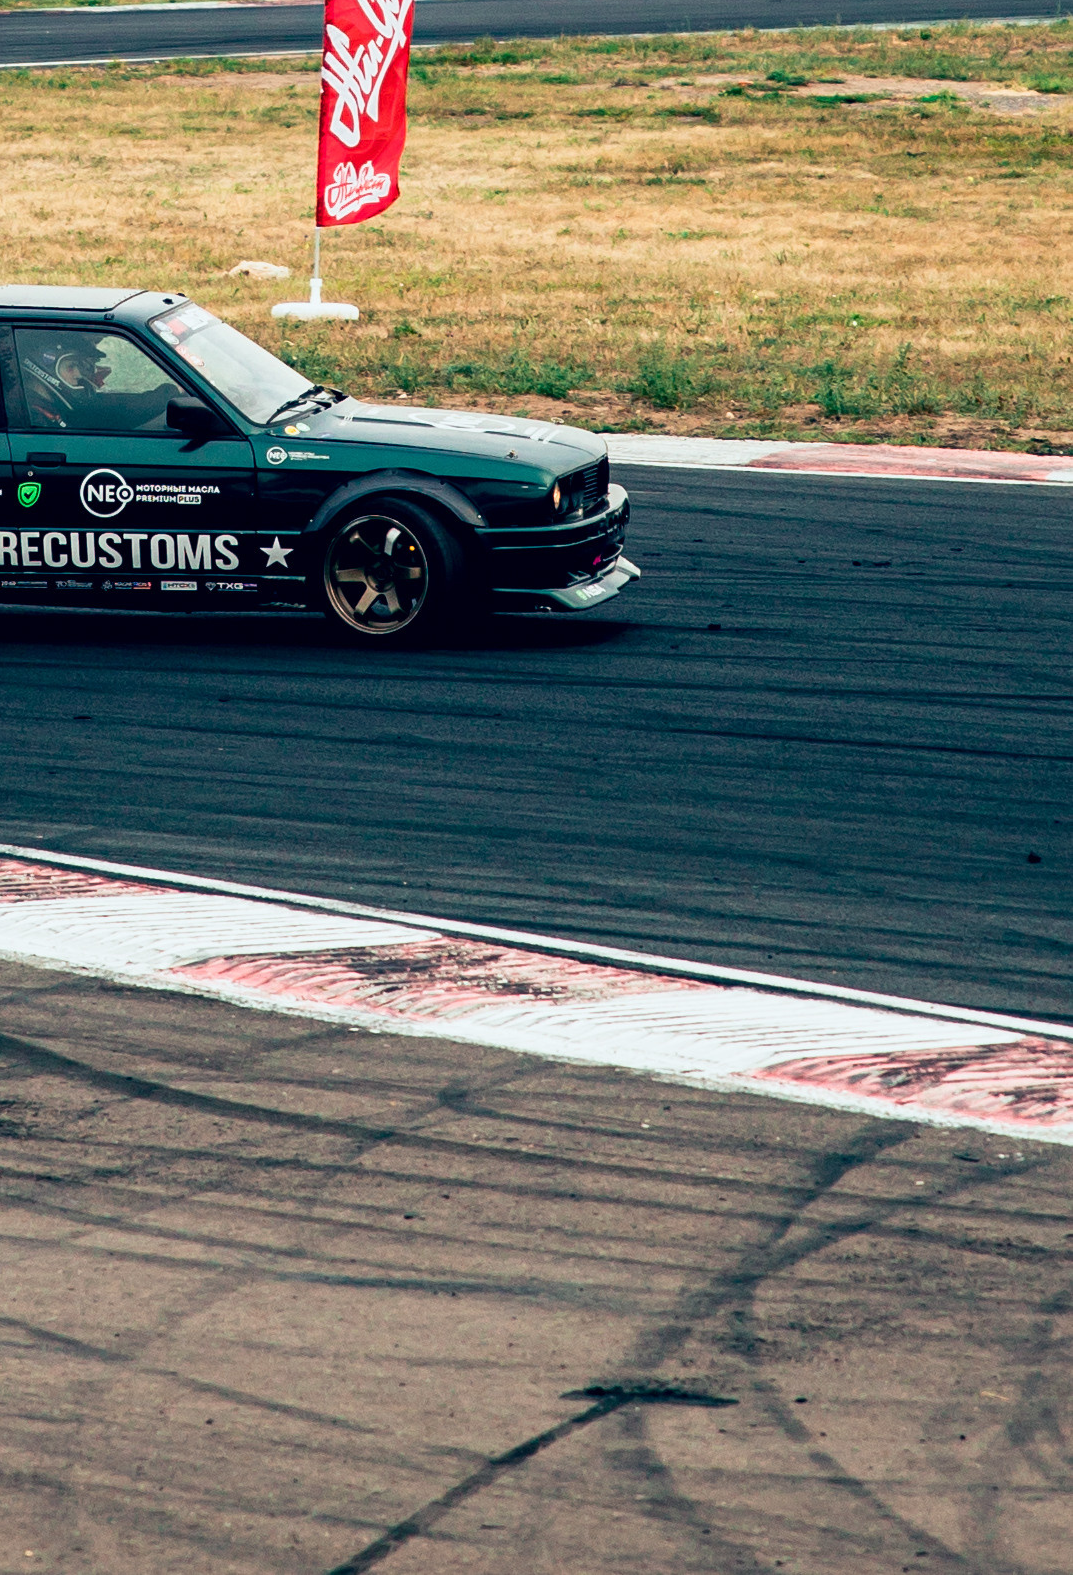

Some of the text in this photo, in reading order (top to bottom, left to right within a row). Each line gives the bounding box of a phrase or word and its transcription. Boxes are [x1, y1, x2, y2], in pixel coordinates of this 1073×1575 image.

[87, 484, 134, 503] NEO
[136, 485, 220, 494] МОТОРНЫЕ МАСЛА
[136, 494, 201, 504] PREMIUM PLUS
